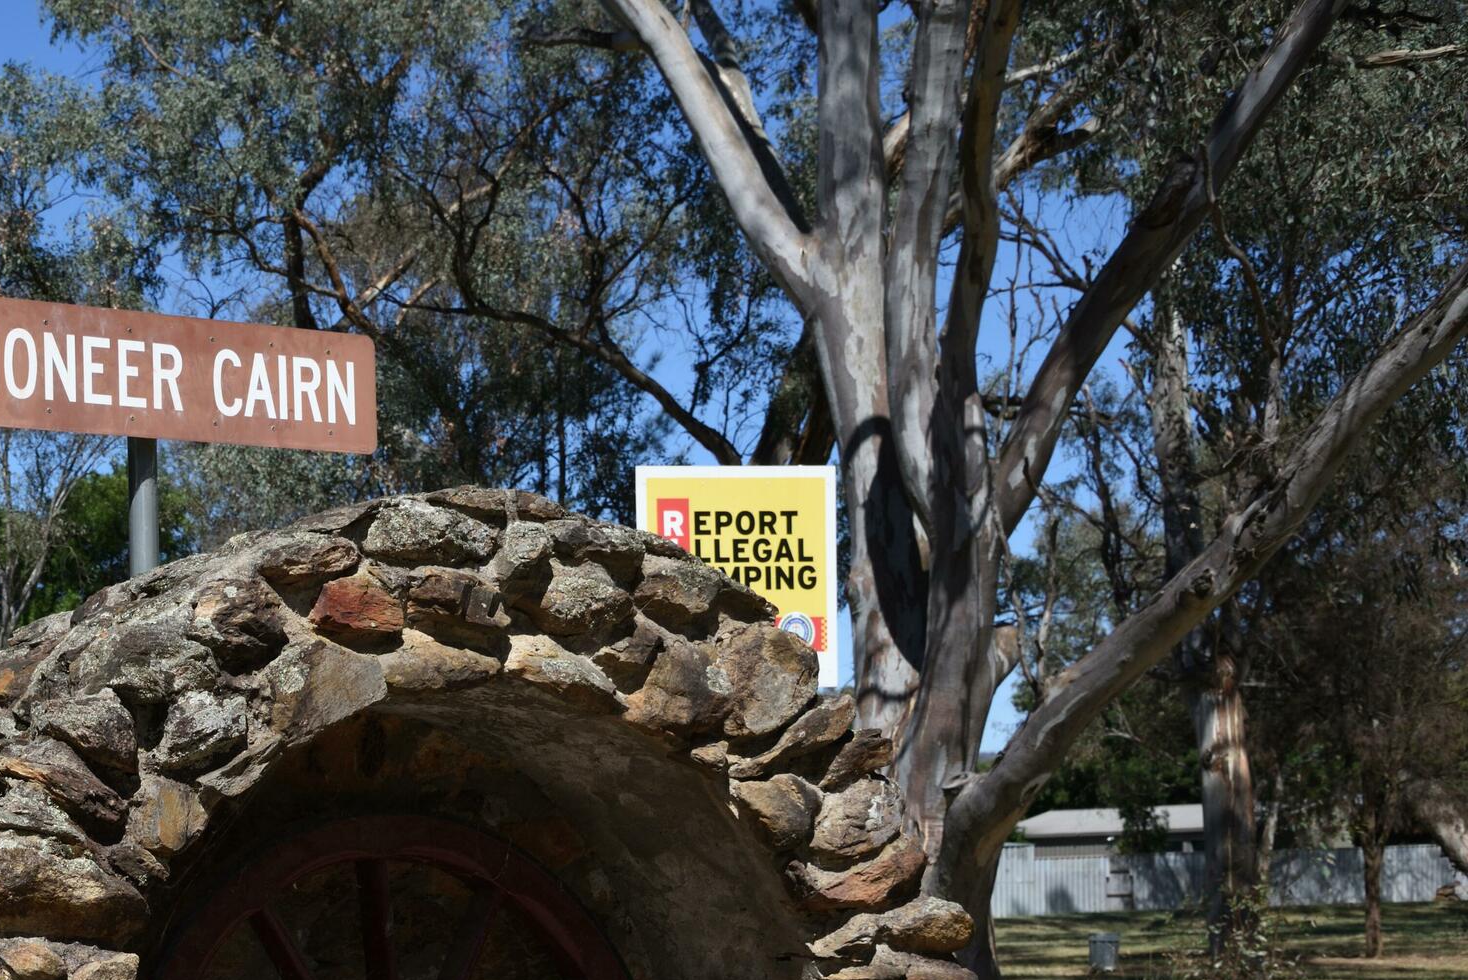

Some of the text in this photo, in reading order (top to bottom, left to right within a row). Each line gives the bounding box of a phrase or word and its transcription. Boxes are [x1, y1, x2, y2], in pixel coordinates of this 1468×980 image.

[212, 348, 356, 426] CAIRN
[663, 510, 798, 536] REPORT
[674, 538, 814, 563] LLEGAL
